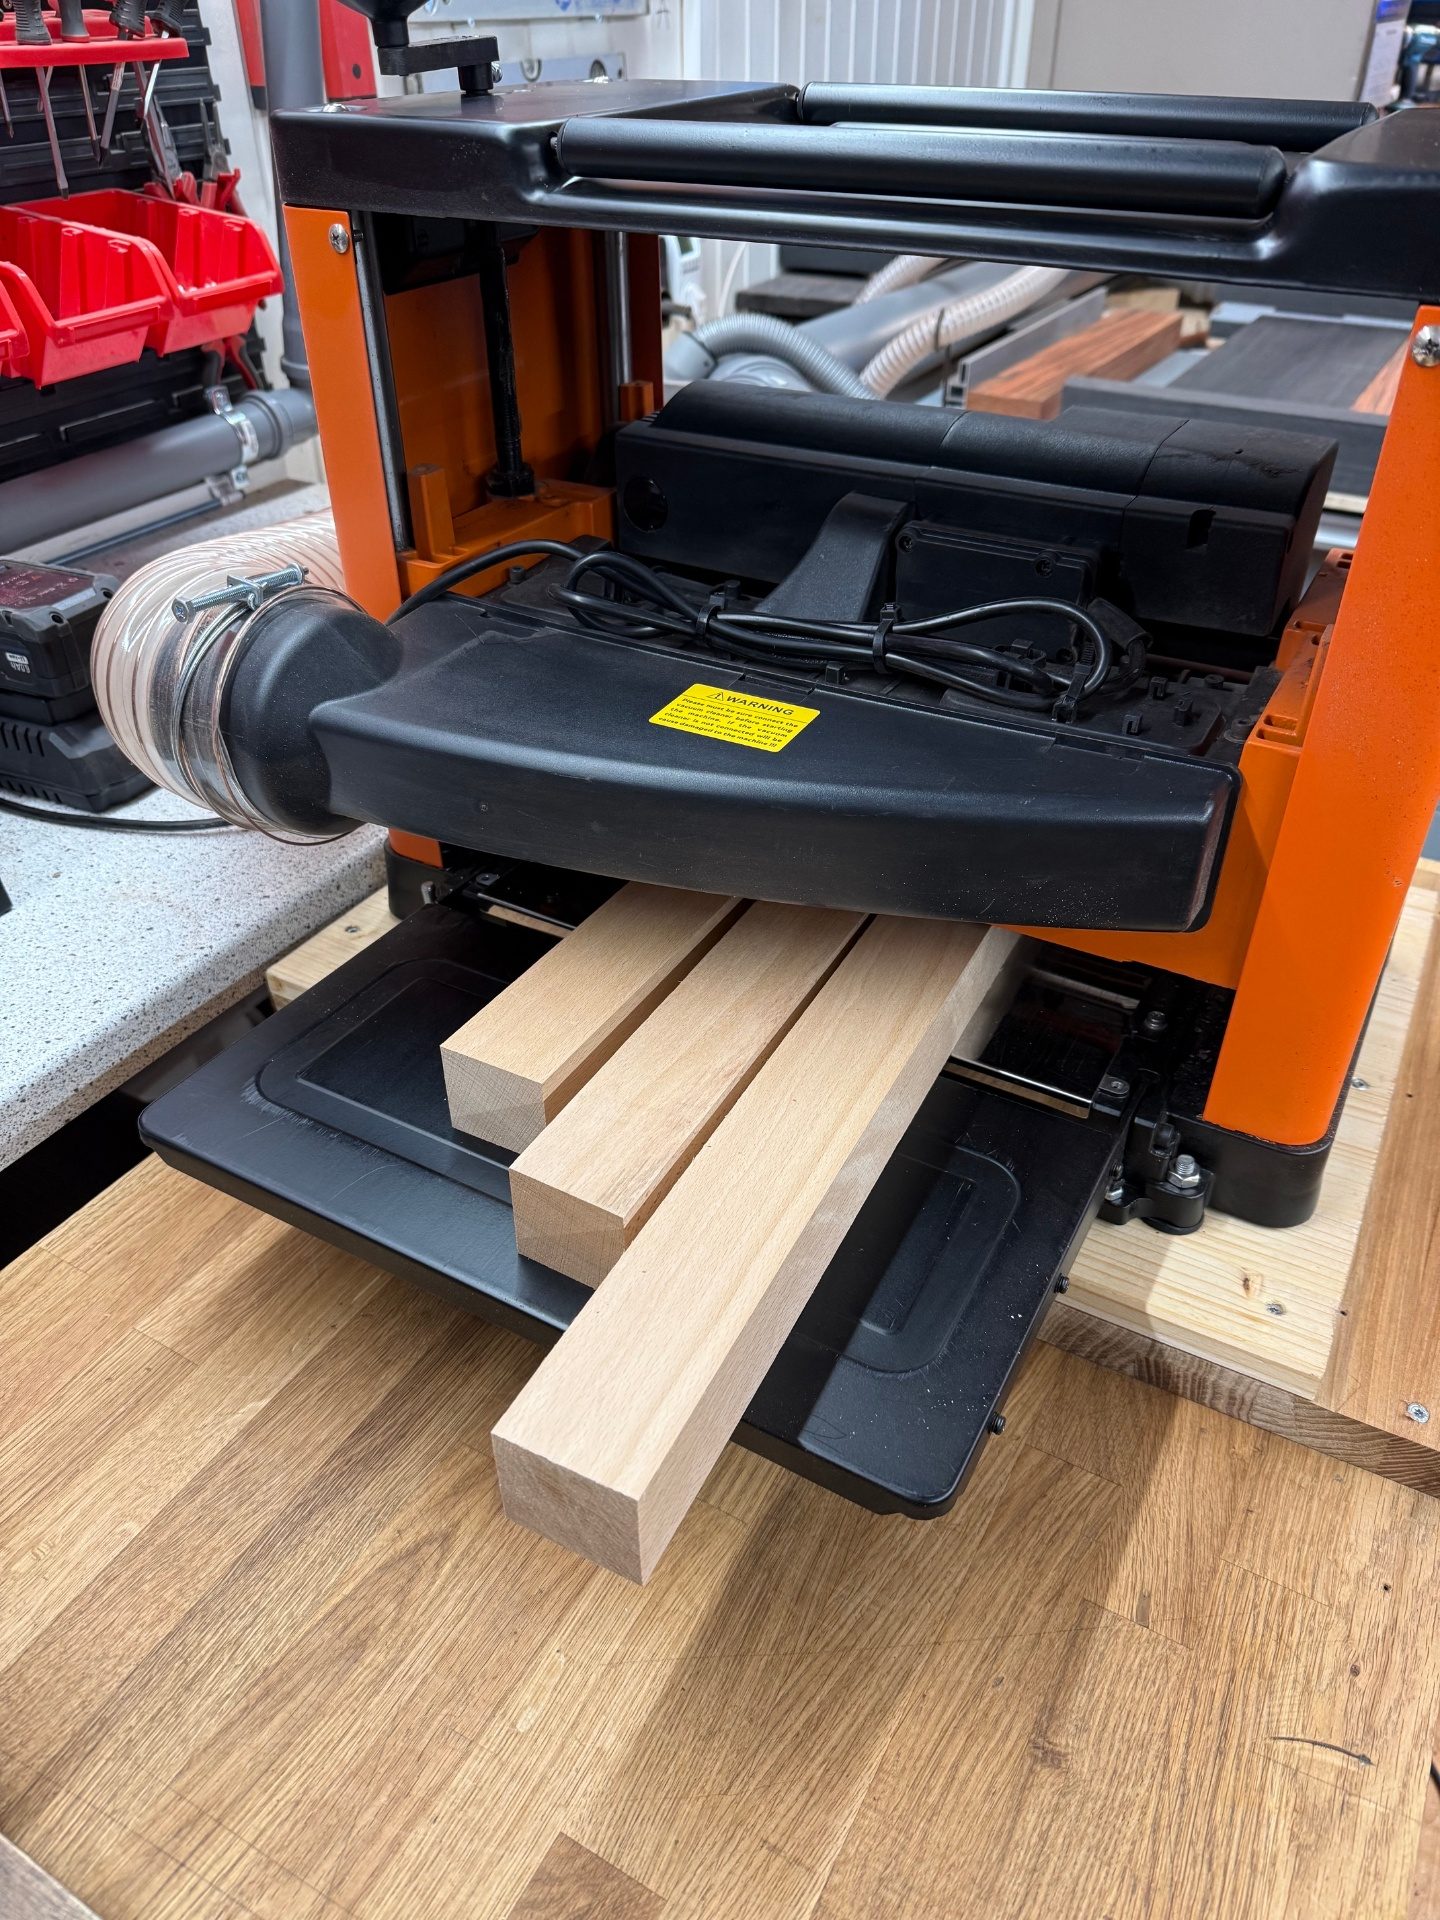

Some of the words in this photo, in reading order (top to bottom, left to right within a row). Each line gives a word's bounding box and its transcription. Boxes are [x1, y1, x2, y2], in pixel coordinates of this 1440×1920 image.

[682, 698, 704, 706] Please
[754, 716, 784, 724] connect
[726, 695, 795, 716] WARNING
[677, 704, 704, 712] vacuum
[706, 710, 733, 718] cleaner
[763, 724, 793, 733] starting
[688, 712, 721, 722] machine.
[758, 728, 788, 737] vacuum
[716, 725, 755, 736] connected
[679, 722, 714, 732] damaged
[737, 736, 768, 745] machine
